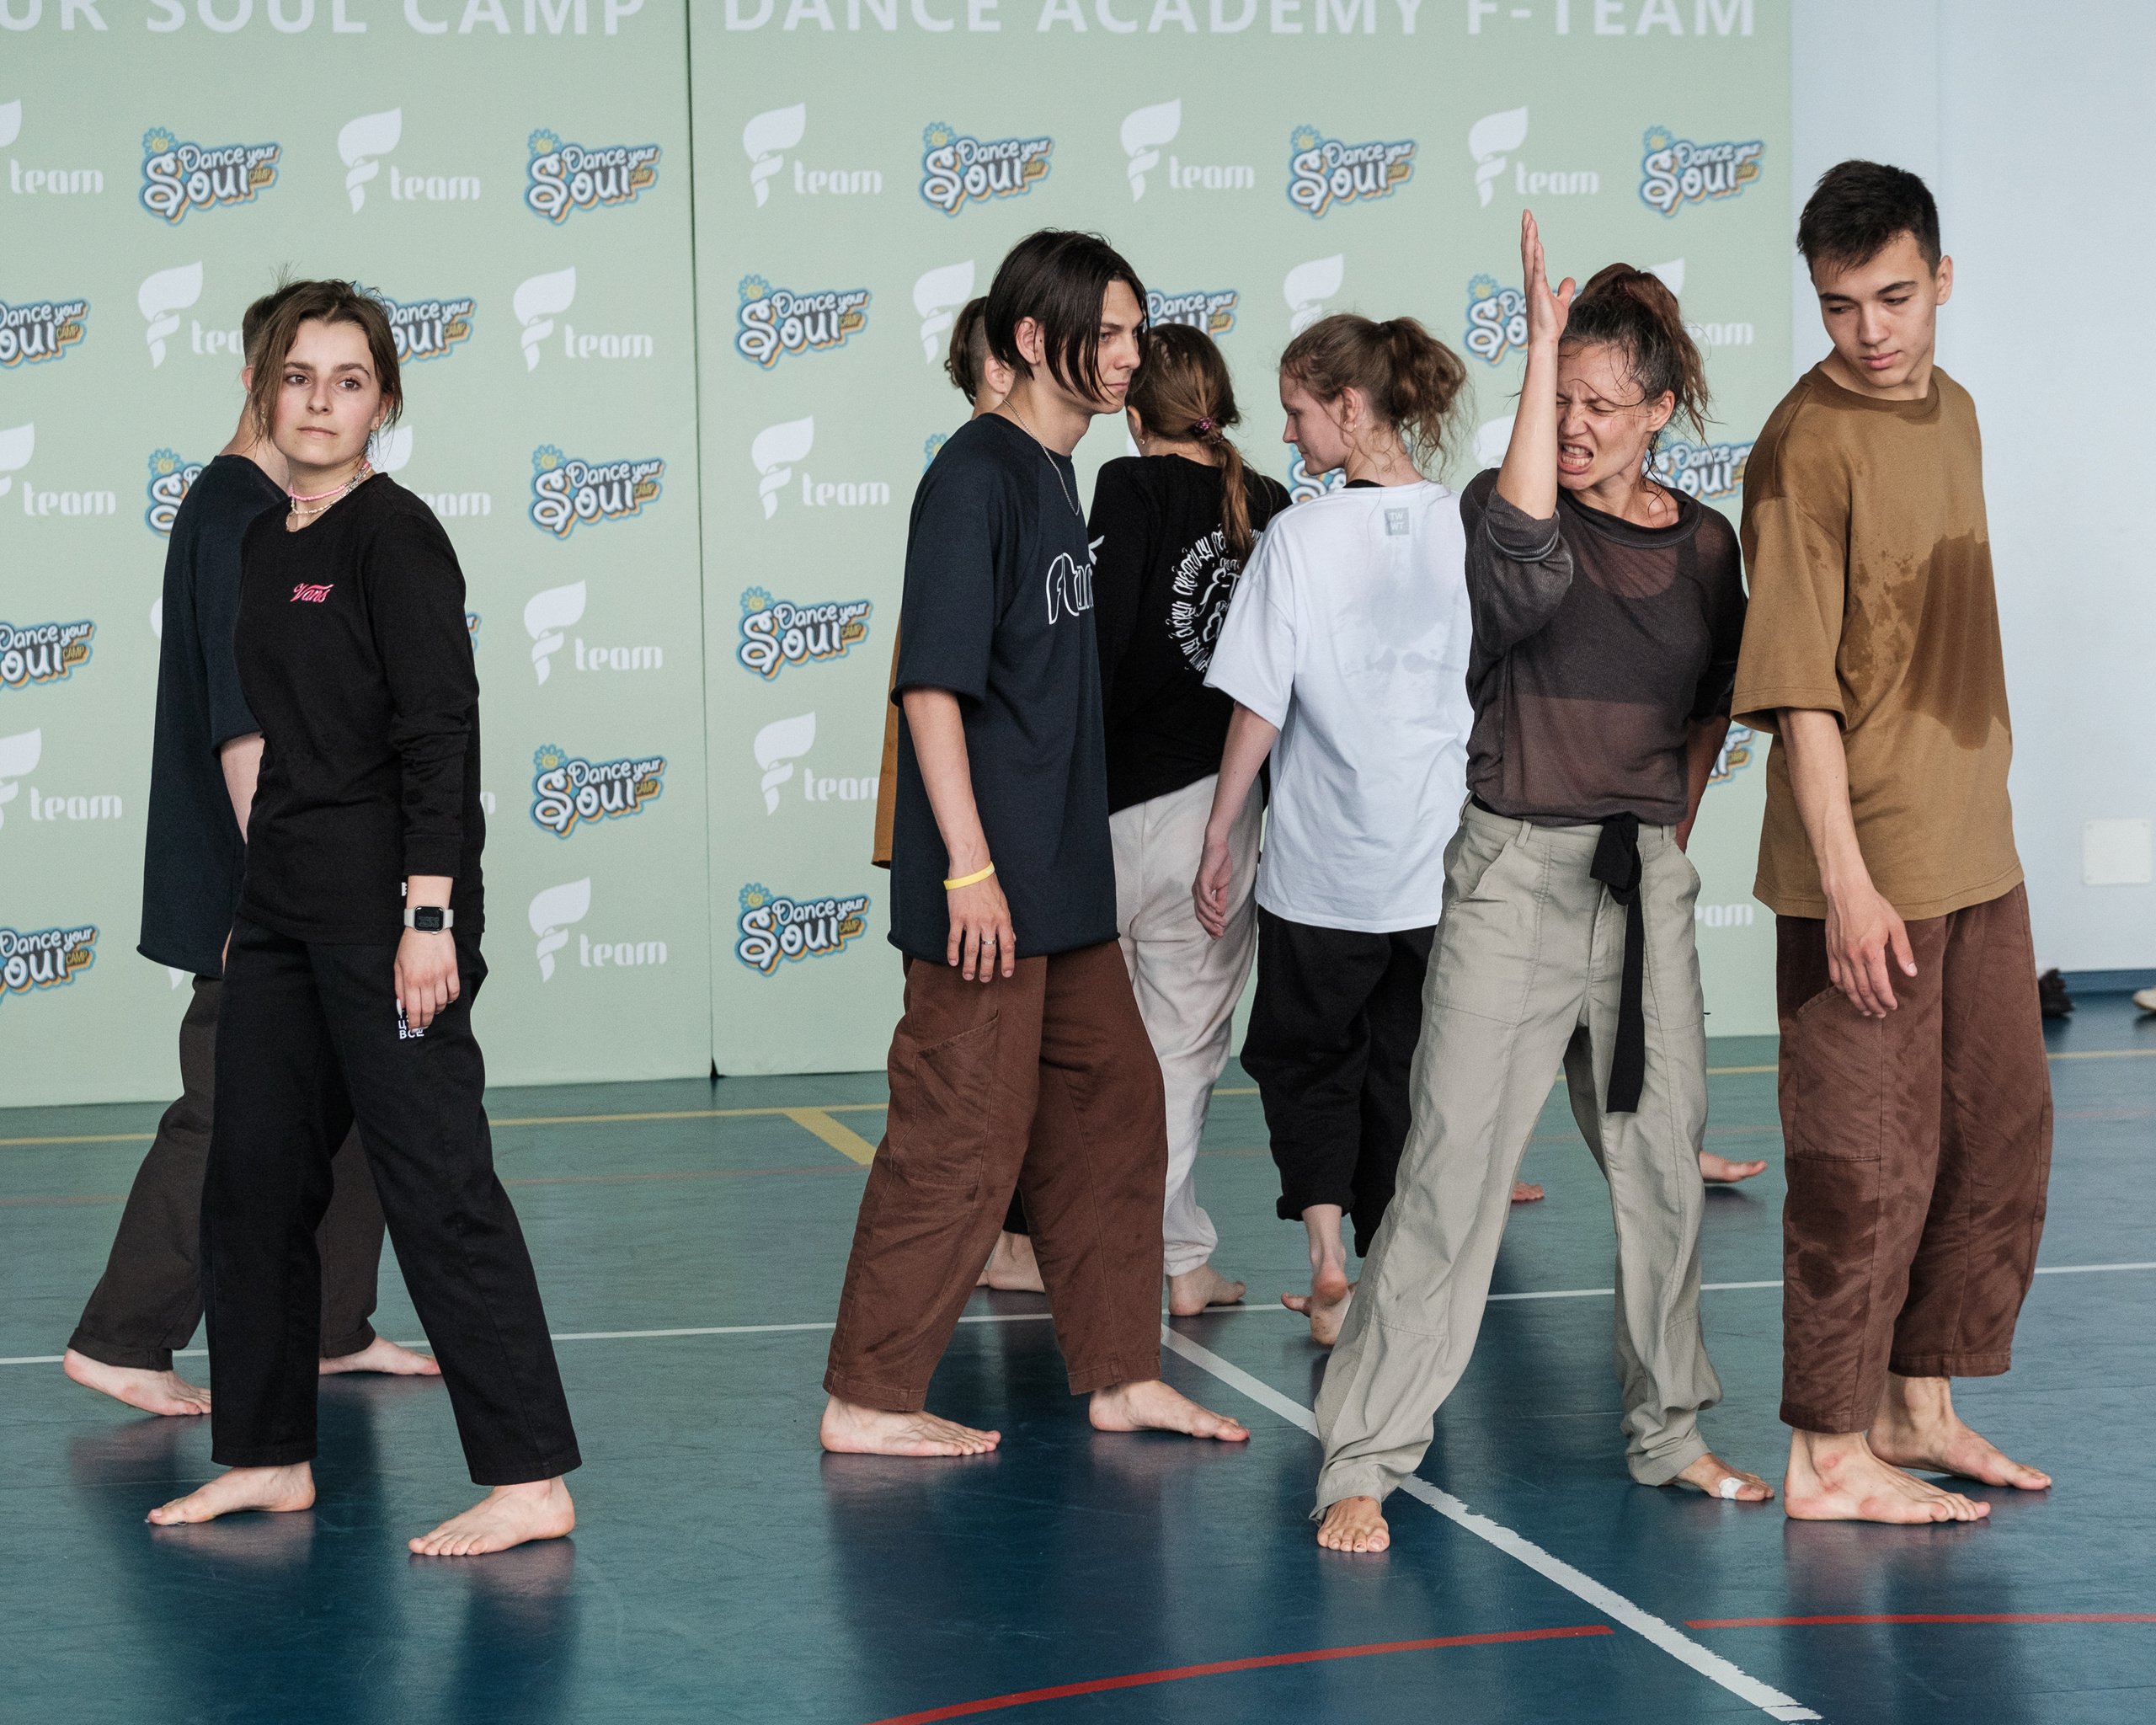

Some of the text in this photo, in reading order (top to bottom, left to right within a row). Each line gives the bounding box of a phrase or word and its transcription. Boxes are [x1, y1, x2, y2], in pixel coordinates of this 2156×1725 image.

[147, 0, 367, 33] SOUL
[403, 0, 645, 35] CAMP
[725, 0, 1754, 36] DANCE ACADEMY F-TEAM
[178, 146, 245, 172] Dance
[562, 146, 626, 172] Dance
[955, 139, 1019, 167] Dance
[1321, 142, 1385, 168] Dance
[10, 159, 104, 194] team
[143, 152, 248, 217] Soul
[390, 165, 481, 200] team
[528, 152, 630, 218] Soul
[794, 159, 883, 195] team
[923, 147, 1022, 210] Soul
[1169, 155, 1255, 190] team
[1291, 149, 1388, 212] Soul
[1516, 162, 1599, 195] team
[1642, 149, 1737, 209] Soul
[771, 291, 835, 318] Dance
[0, 321, 56, 360] oul
[191, 319, 244, 355] tea
[392, 320, 446, 356] oul
[564, 324, 653, 358] team
[739, 298, 839, 363] Soul
[566, 461, 630, 487] Dance
[802, 472, 889, 506] team
[24, 481, 116, 516] team
[532, 469, 634, 533] Soul
[290, 583, 334, 602] Vans
[773, 603, 837, 629] Dance
[575, 638, 663, 671] team
[741, 610, 841, 674] Soul
[0, 643, 64, 681] oul
[568, 760, 631, 784] Dance
[30, 786, 123, 821] team
[534, 769, 636, 832] Soul
[771, 900, 835, 926] Dance
[579, 933, 667, 967] team
[739, 906, 840, 969] Soul
[2, 948, 67, 988] oul
